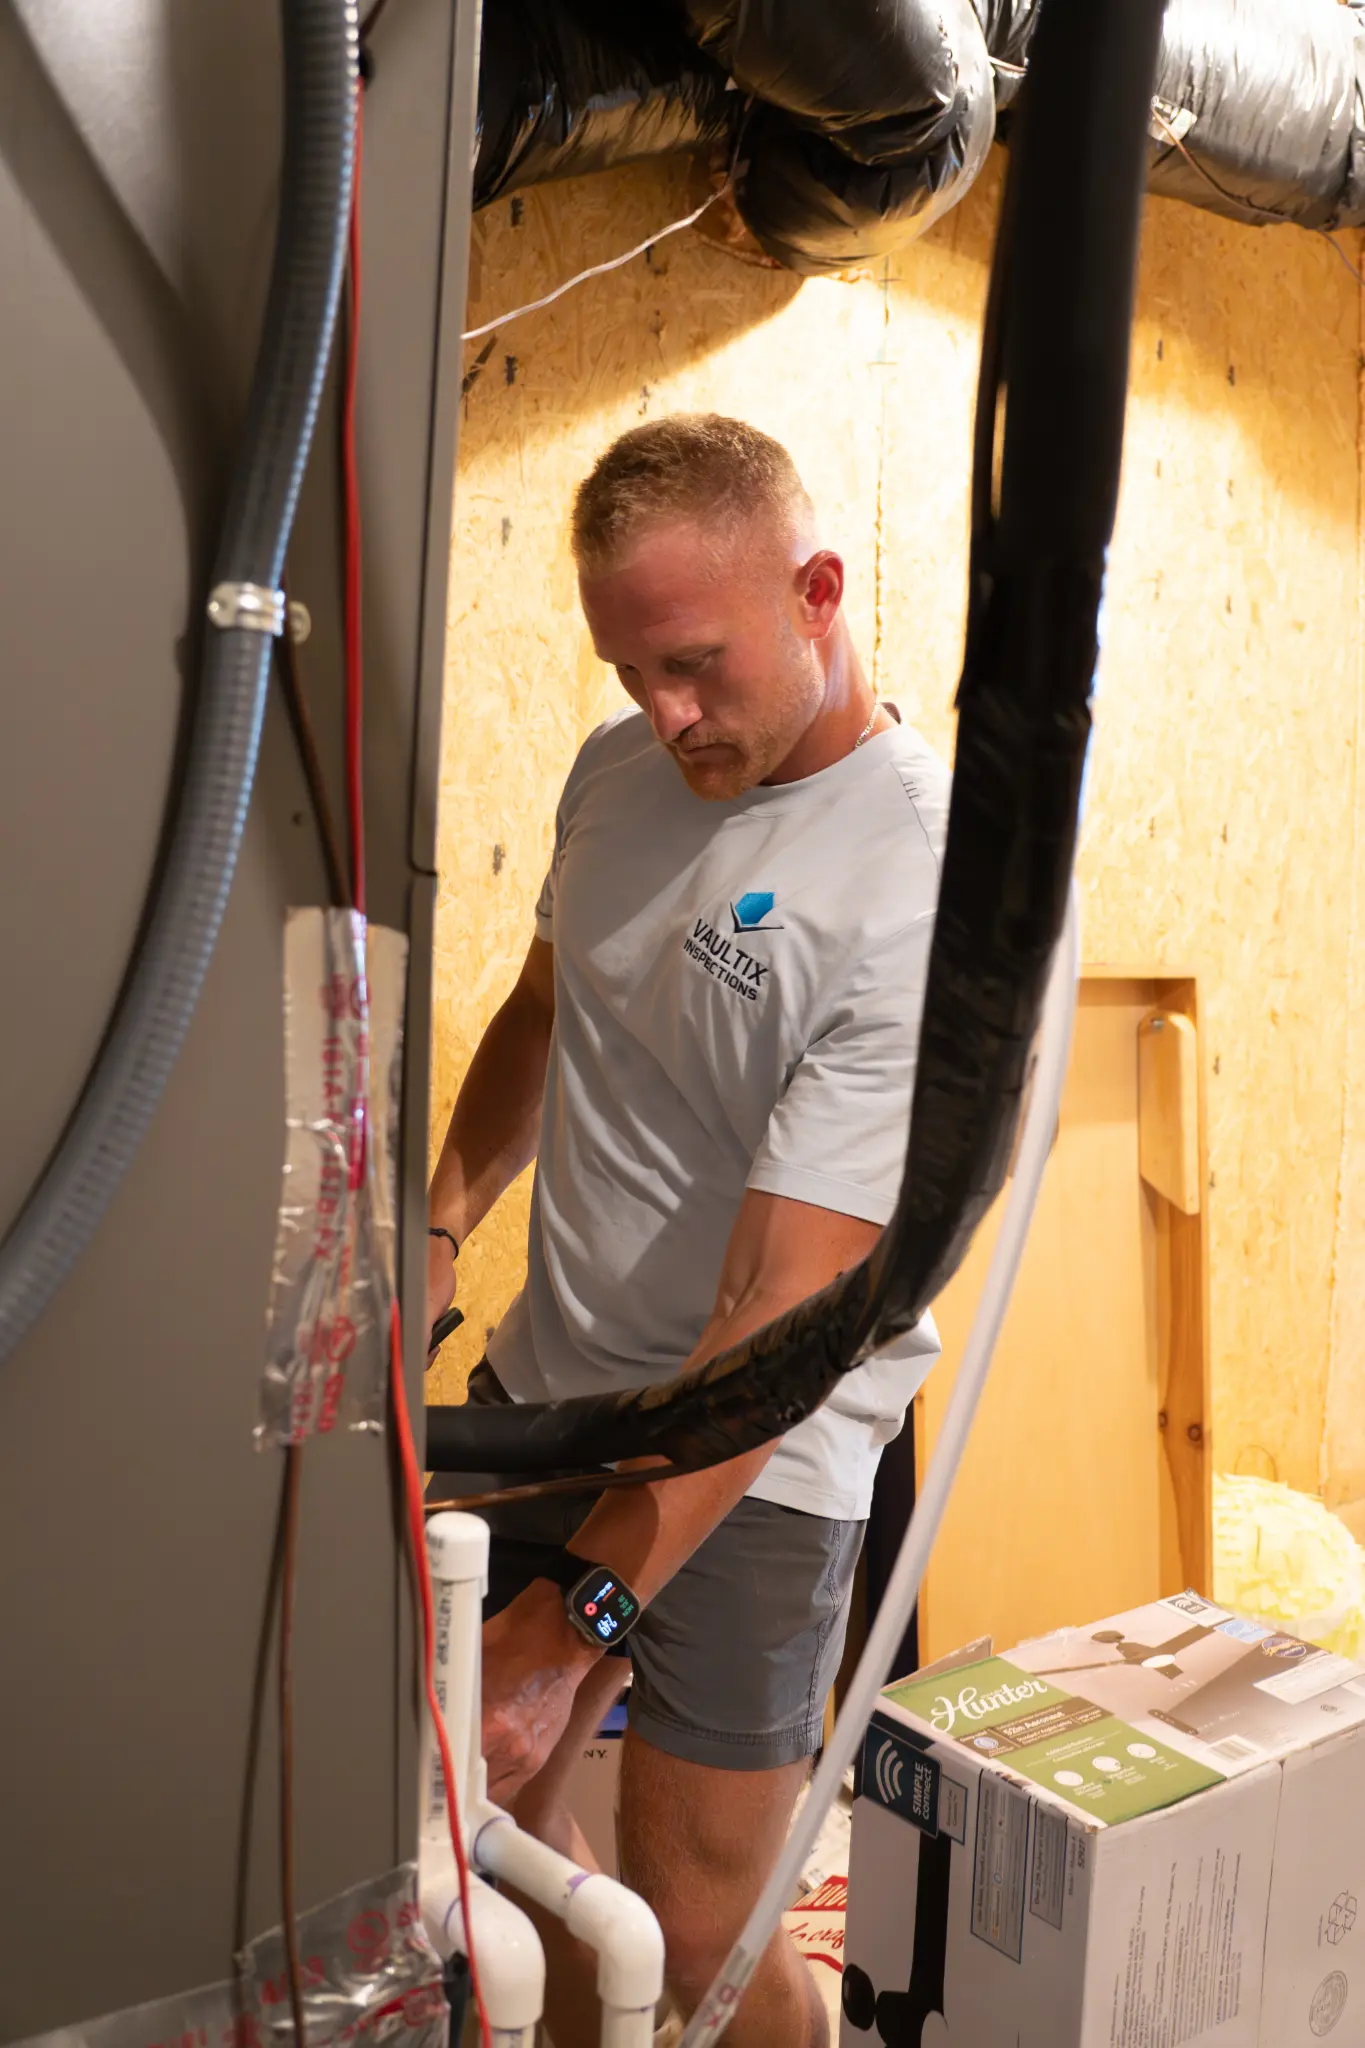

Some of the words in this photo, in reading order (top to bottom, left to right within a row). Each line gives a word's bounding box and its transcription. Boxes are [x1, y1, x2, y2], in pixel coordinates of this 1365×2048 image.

[683, 938, 758, 1001] INSPECTIONS
[692, 918, 769, 986] VAULTIX
[930, 1679, 1047, 1733] Hunter
[912, 1761, 925, 1817] SIMPLE
[921, 1766, 932, 1821] connect
